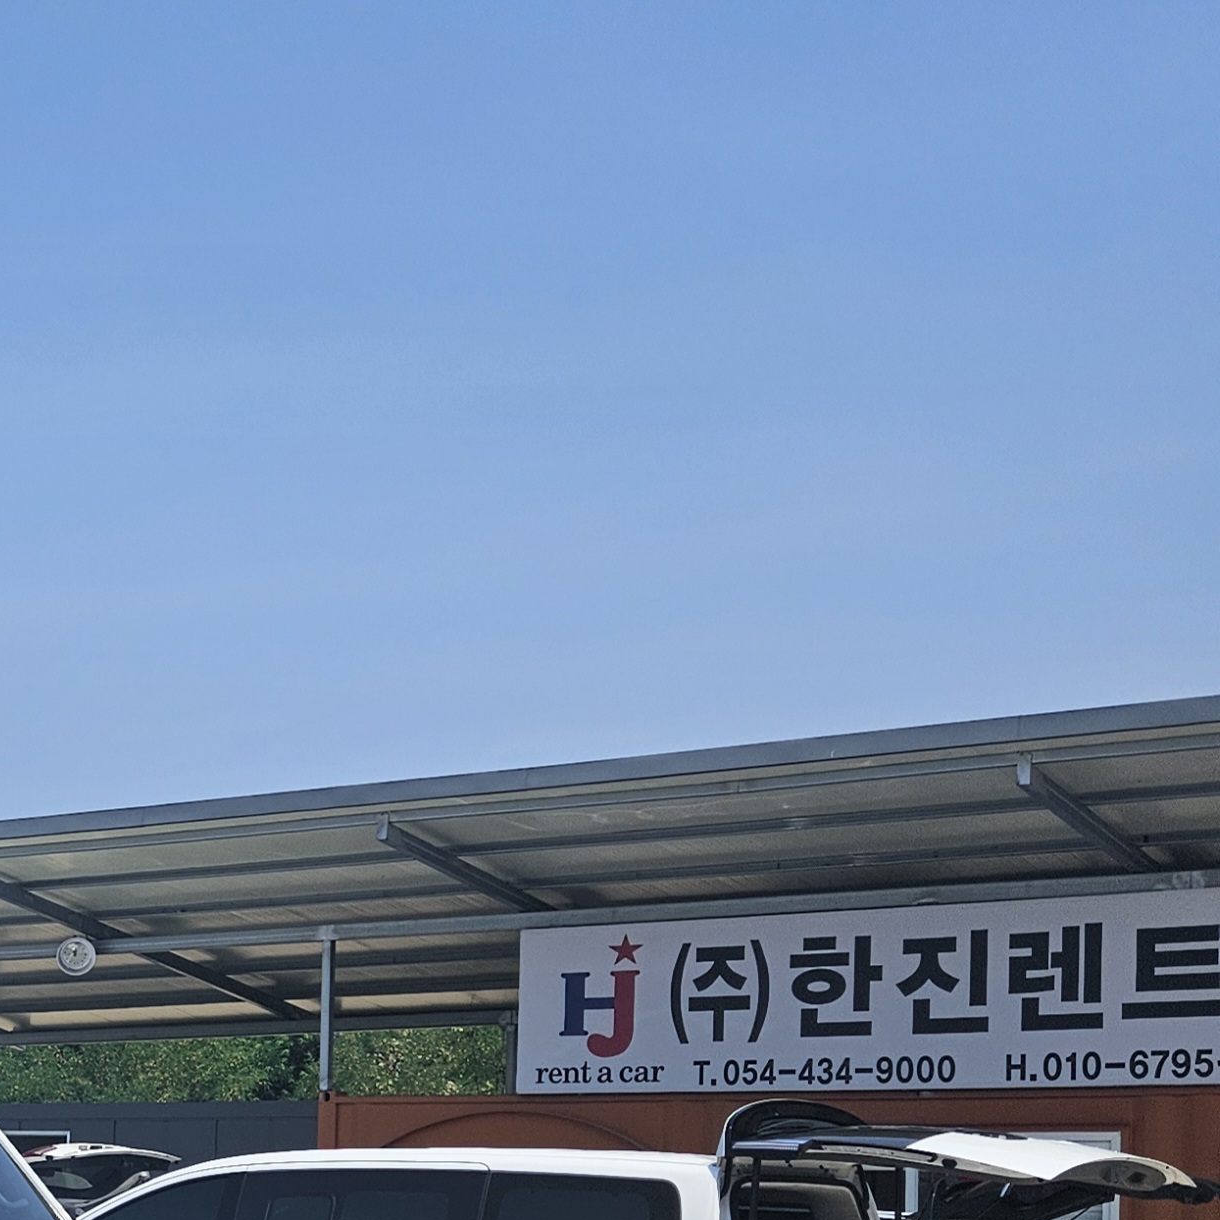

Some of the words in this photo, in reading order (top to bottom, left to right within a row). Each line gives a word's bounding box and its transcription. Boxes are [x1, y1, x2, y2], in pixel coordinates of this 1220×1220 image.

[535, 1061, 591, 1084] rent
[597, 1066, 614, 1084] a
[619, 1065, 664, 1083] car
[693, 1055, 956, 1086] T.054-434-9000
[1006, 1049, 1220, 1081] H.010-6795
